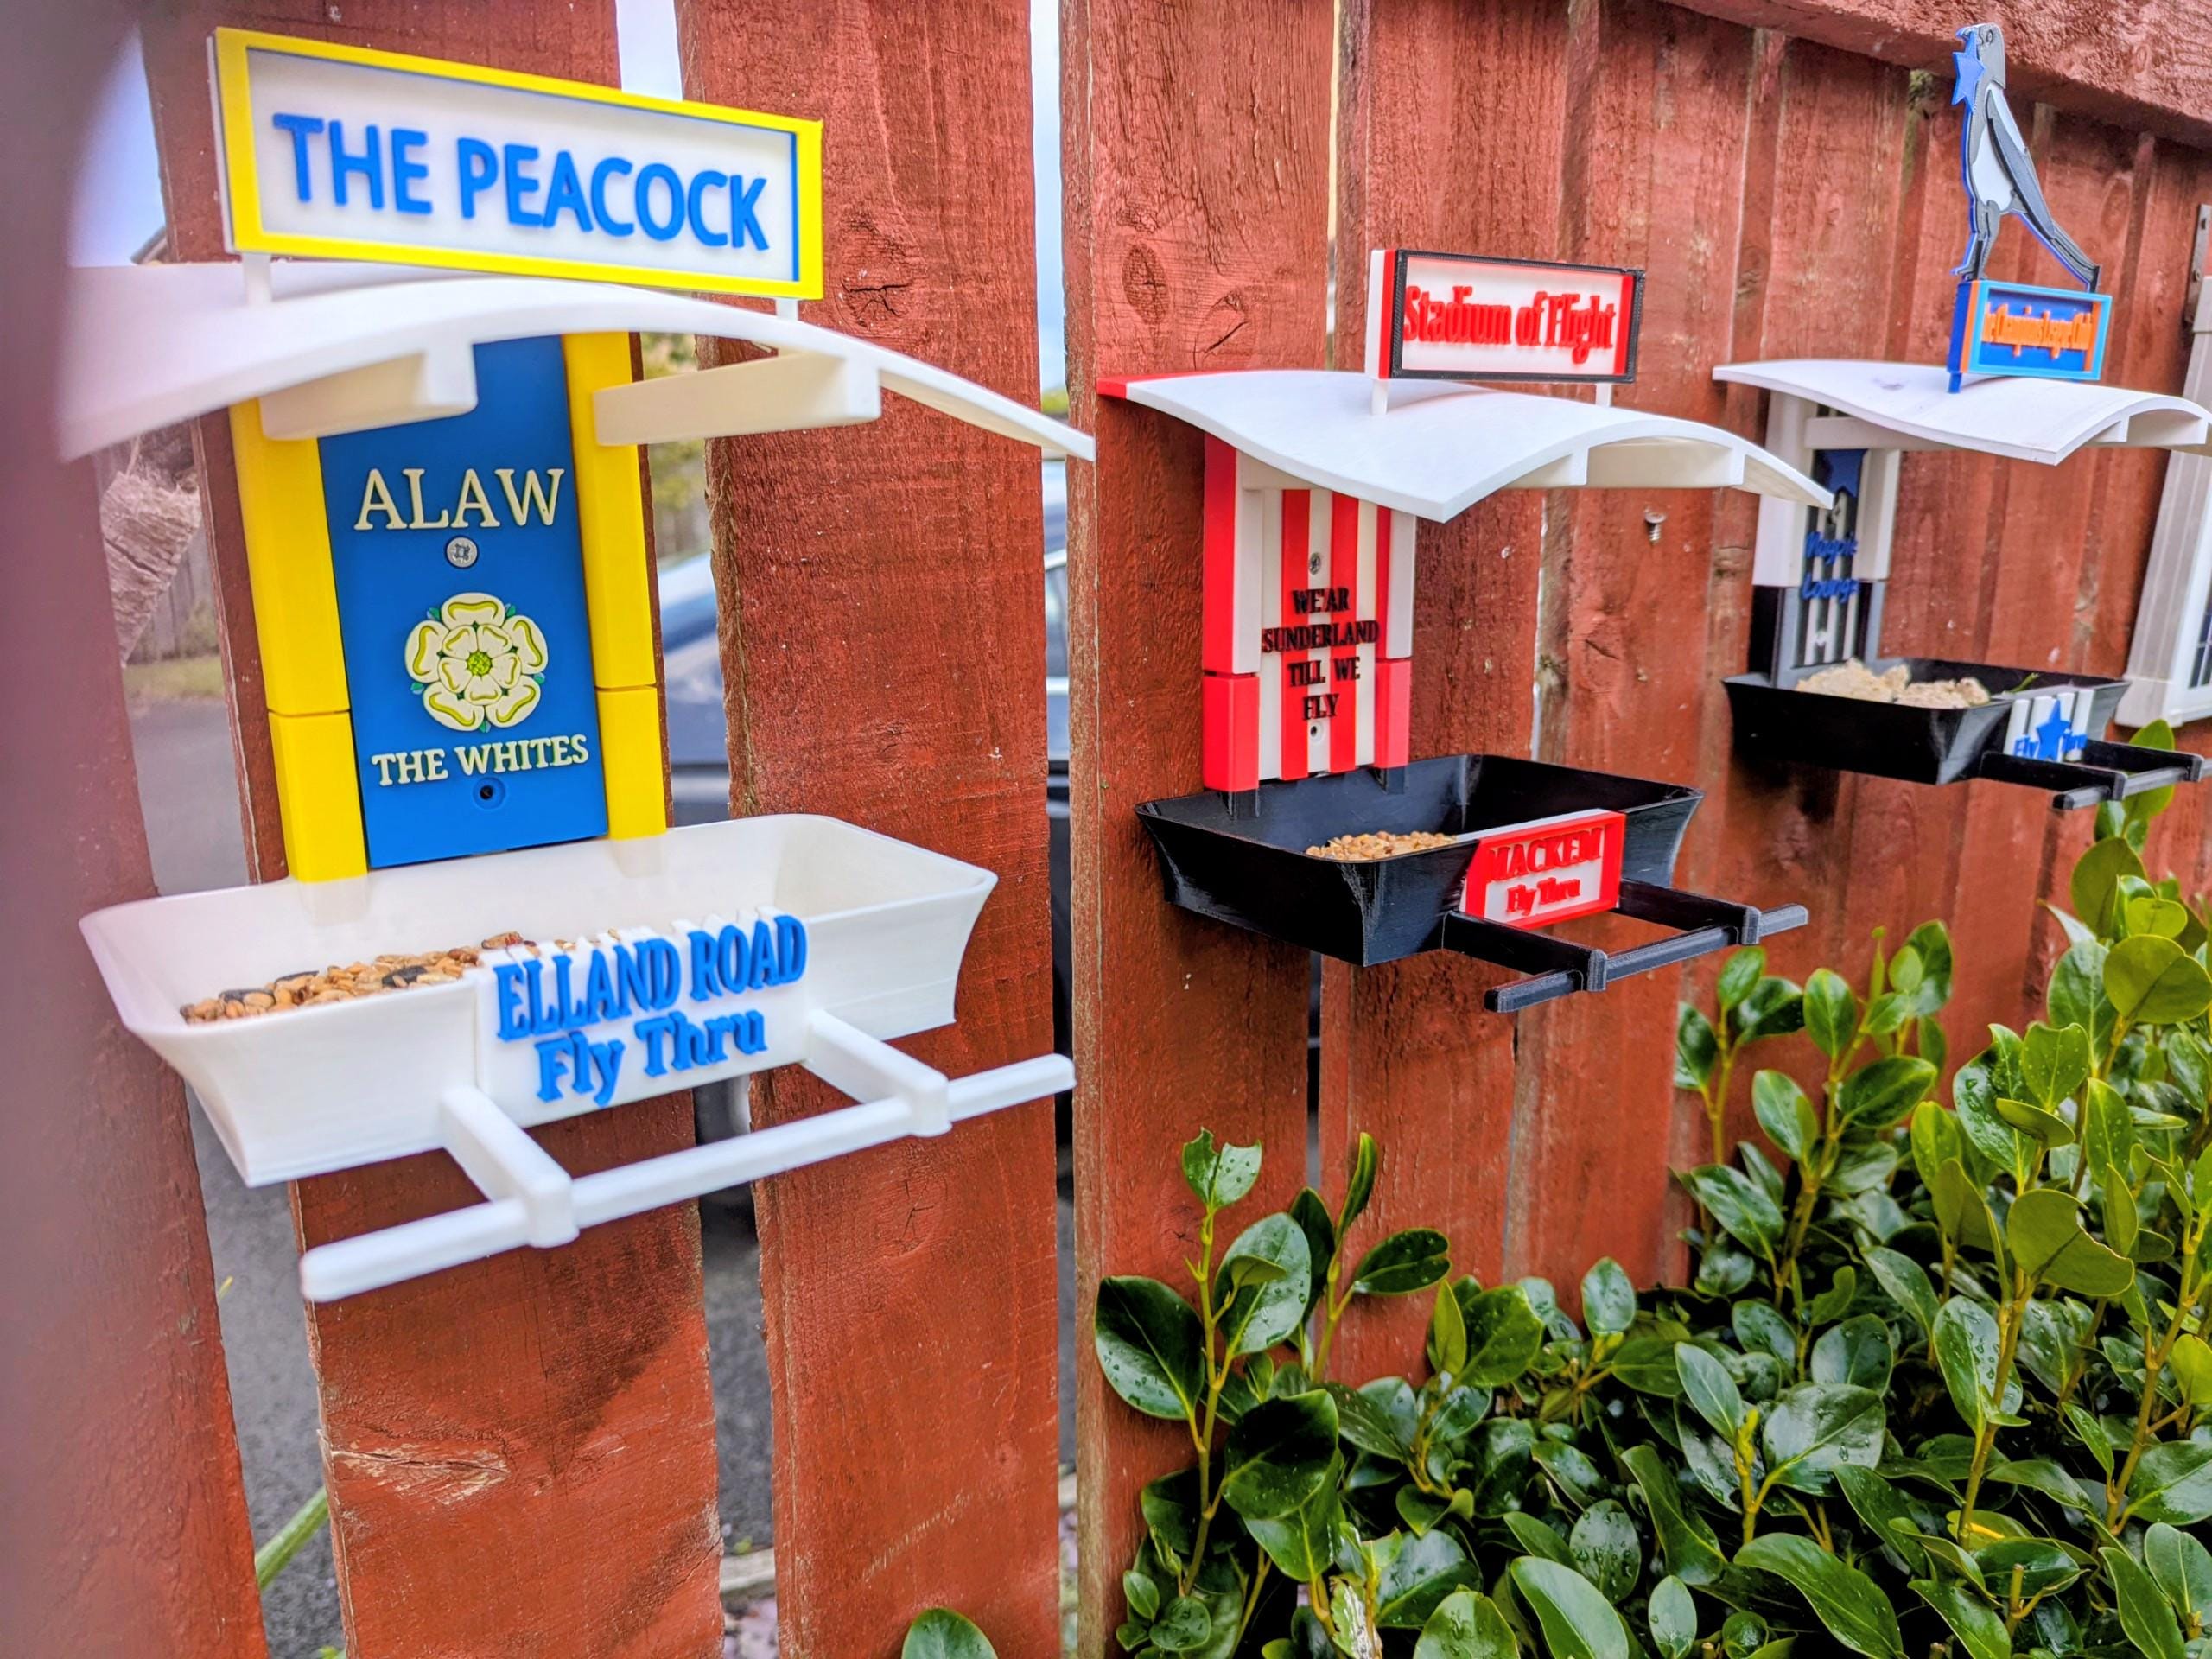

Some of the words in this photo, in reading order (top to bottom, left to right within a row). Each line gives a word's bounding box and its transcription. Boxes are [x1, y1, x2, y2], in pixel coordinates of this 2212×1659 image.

[273, 113, 432, 214] THE
[457, 137, 768, 251] PEACOCK
[1402, 286, 1511, 345] Stadium
[1516, 291, 1548, 346] of
[1543, 294, 1616, 364] Flight
[354, 468, 564, 530] ALAW
[1262, 620, 1379, 652] SUNDERLAND
[1287, 660, 1325, 687] TILL
[1333, 657, 1361, 681] WE
[1303, 694, 1339, 720] FLY
[372, 749, 448, 785] THE
[454, 734, 588, 775] WHITES
[1486, 827, 1605, 883] MACKEM
[1506, 884, 1537, 916] Fly
[1537, 877, 1580, 905] Thru
[493, 938, 681, 1042] ELLAND
[688, 915, 807, 1001] ROAD
[534, 1031, 625, 1107] Fly
[635, 1010, 768, 1077] Thru
